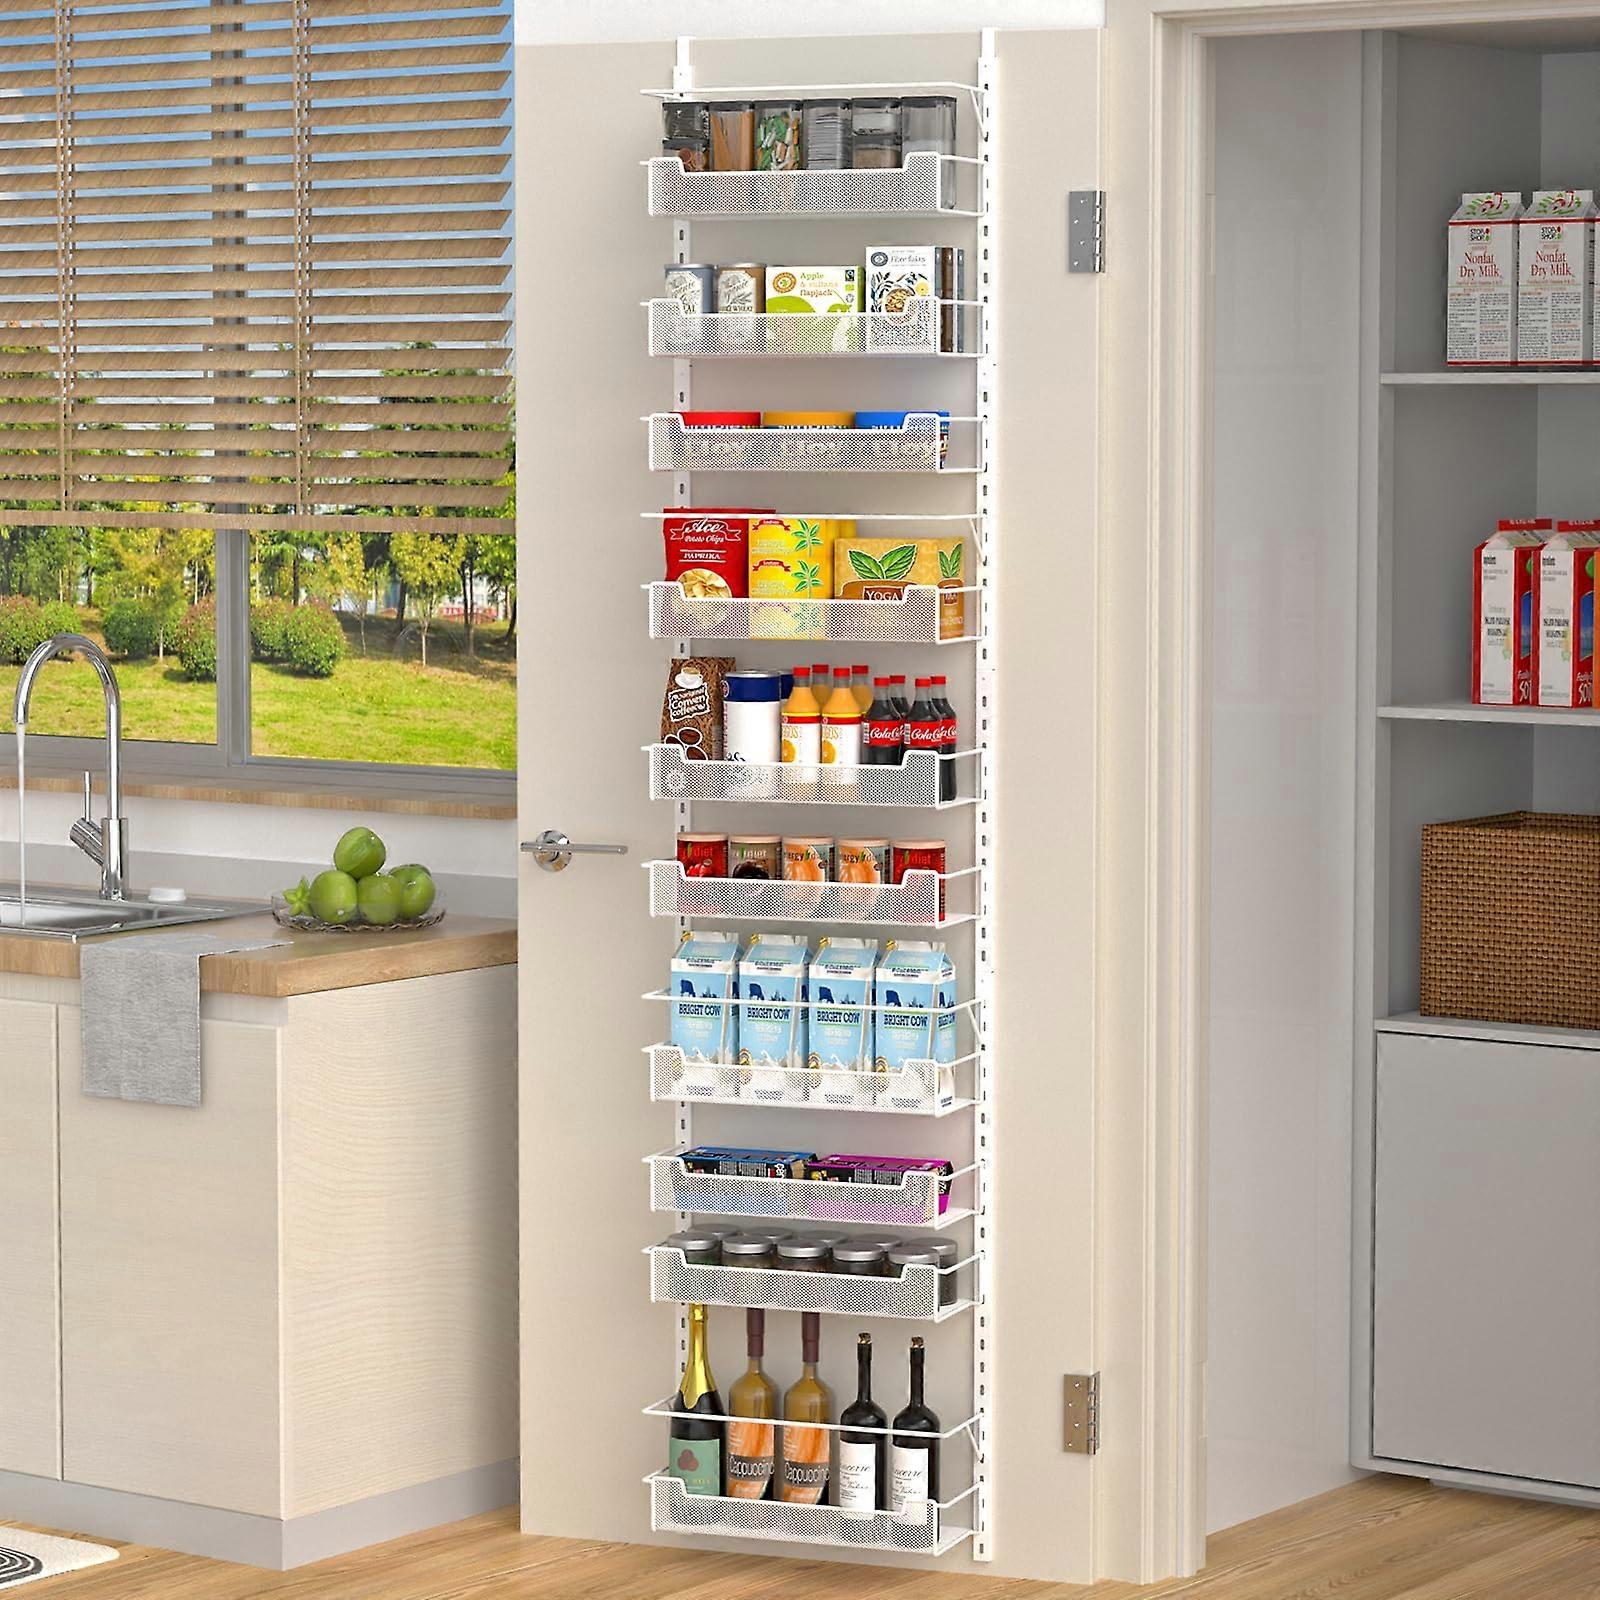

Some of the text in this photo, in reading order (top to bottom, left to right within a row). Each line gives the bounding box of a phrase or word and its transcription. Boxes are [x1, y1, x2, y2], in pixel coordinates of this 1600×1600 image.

[1465, 250, 1494, 264] Nonfat
[1536, 248, 1566, 263] Nonfat
[800, 272, 824, 281] Apple
[1460, 265, 1500, 280] Dry Milk
[1531, 263, 1571, 279] Dry Milk
[800, 288, 833, 297] flapjack
[683, 552, 721, 560] PAPRIKA
[866, 590, 899, 600] YOGA
[679, 1003, 721, 1016] BRIGHT COW
[747, 1007, 791, 1020] BRIGHT COW
[816, 1011, 860, 1024] BRIGHT COW
[883, 1014, 928, 1027] BRIGHT COW
[729, 1454, 775, 1478] Cappuccino
[784, 1462, 830, 1484] Cappuccino
